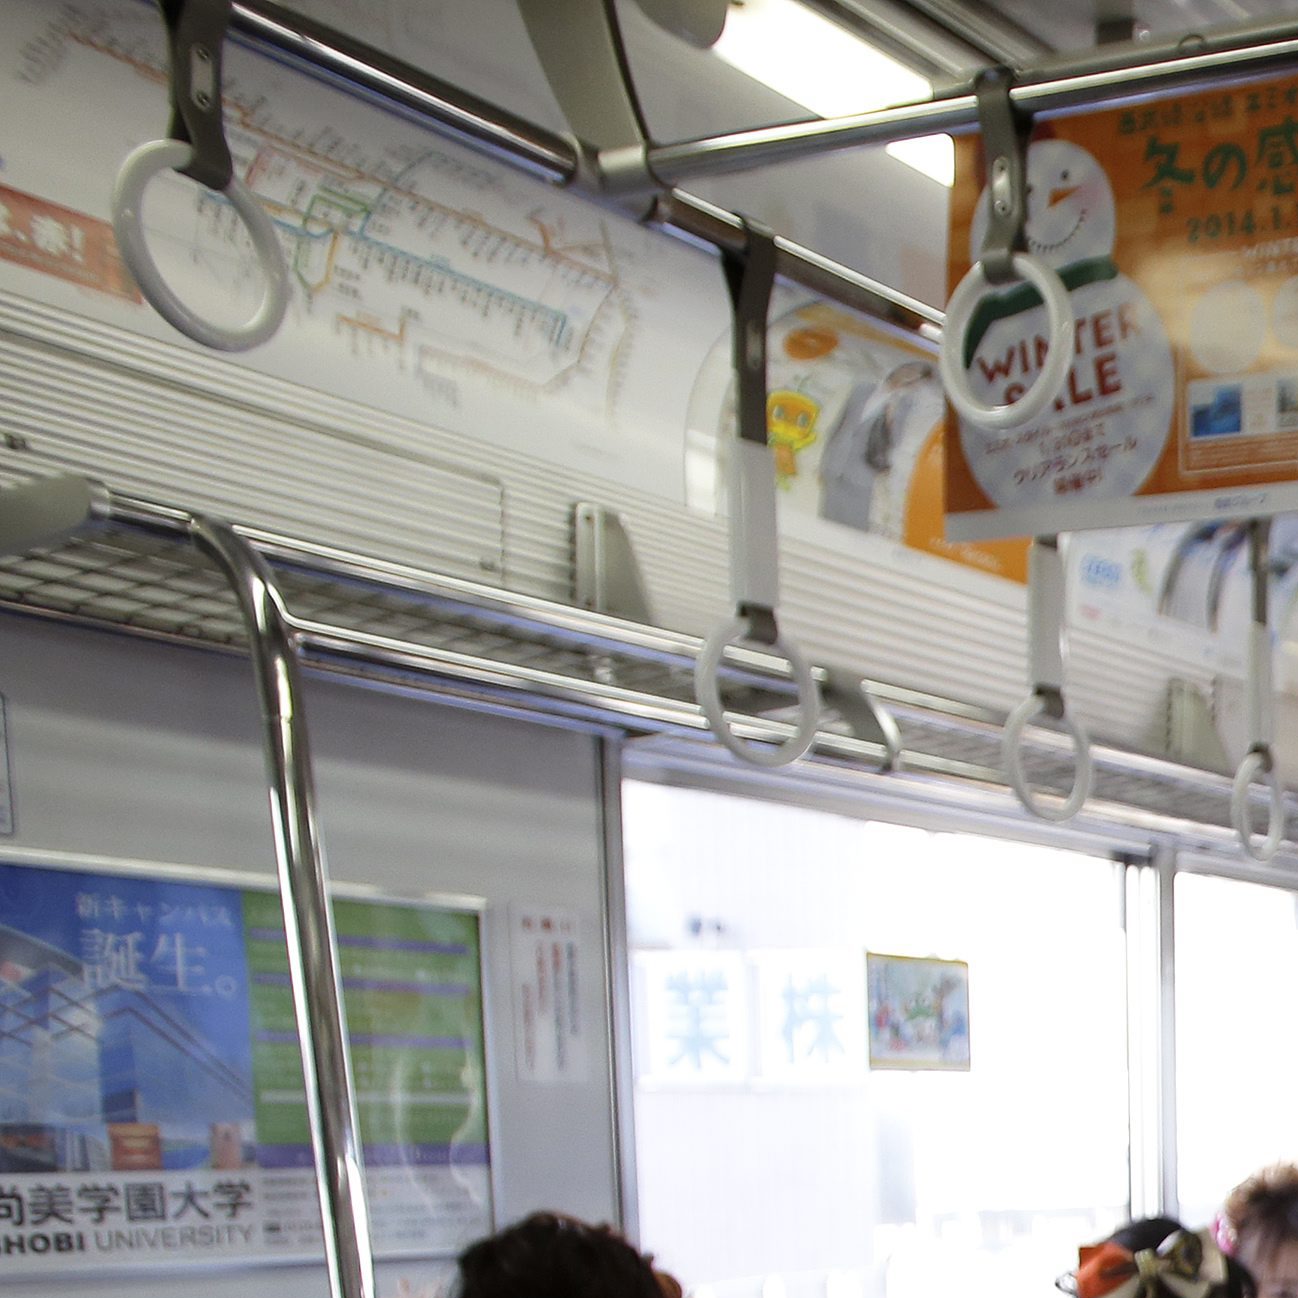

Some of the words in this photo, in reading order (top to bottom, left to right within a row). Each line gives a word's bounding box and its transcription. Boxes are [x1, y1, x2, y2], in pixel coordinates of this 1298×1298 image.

[1004, 353, 1122, 413] SLE
[0, 1232, 86, 1254] HOBI
[95, 1224, 253, 1251] UNIVERSITY
